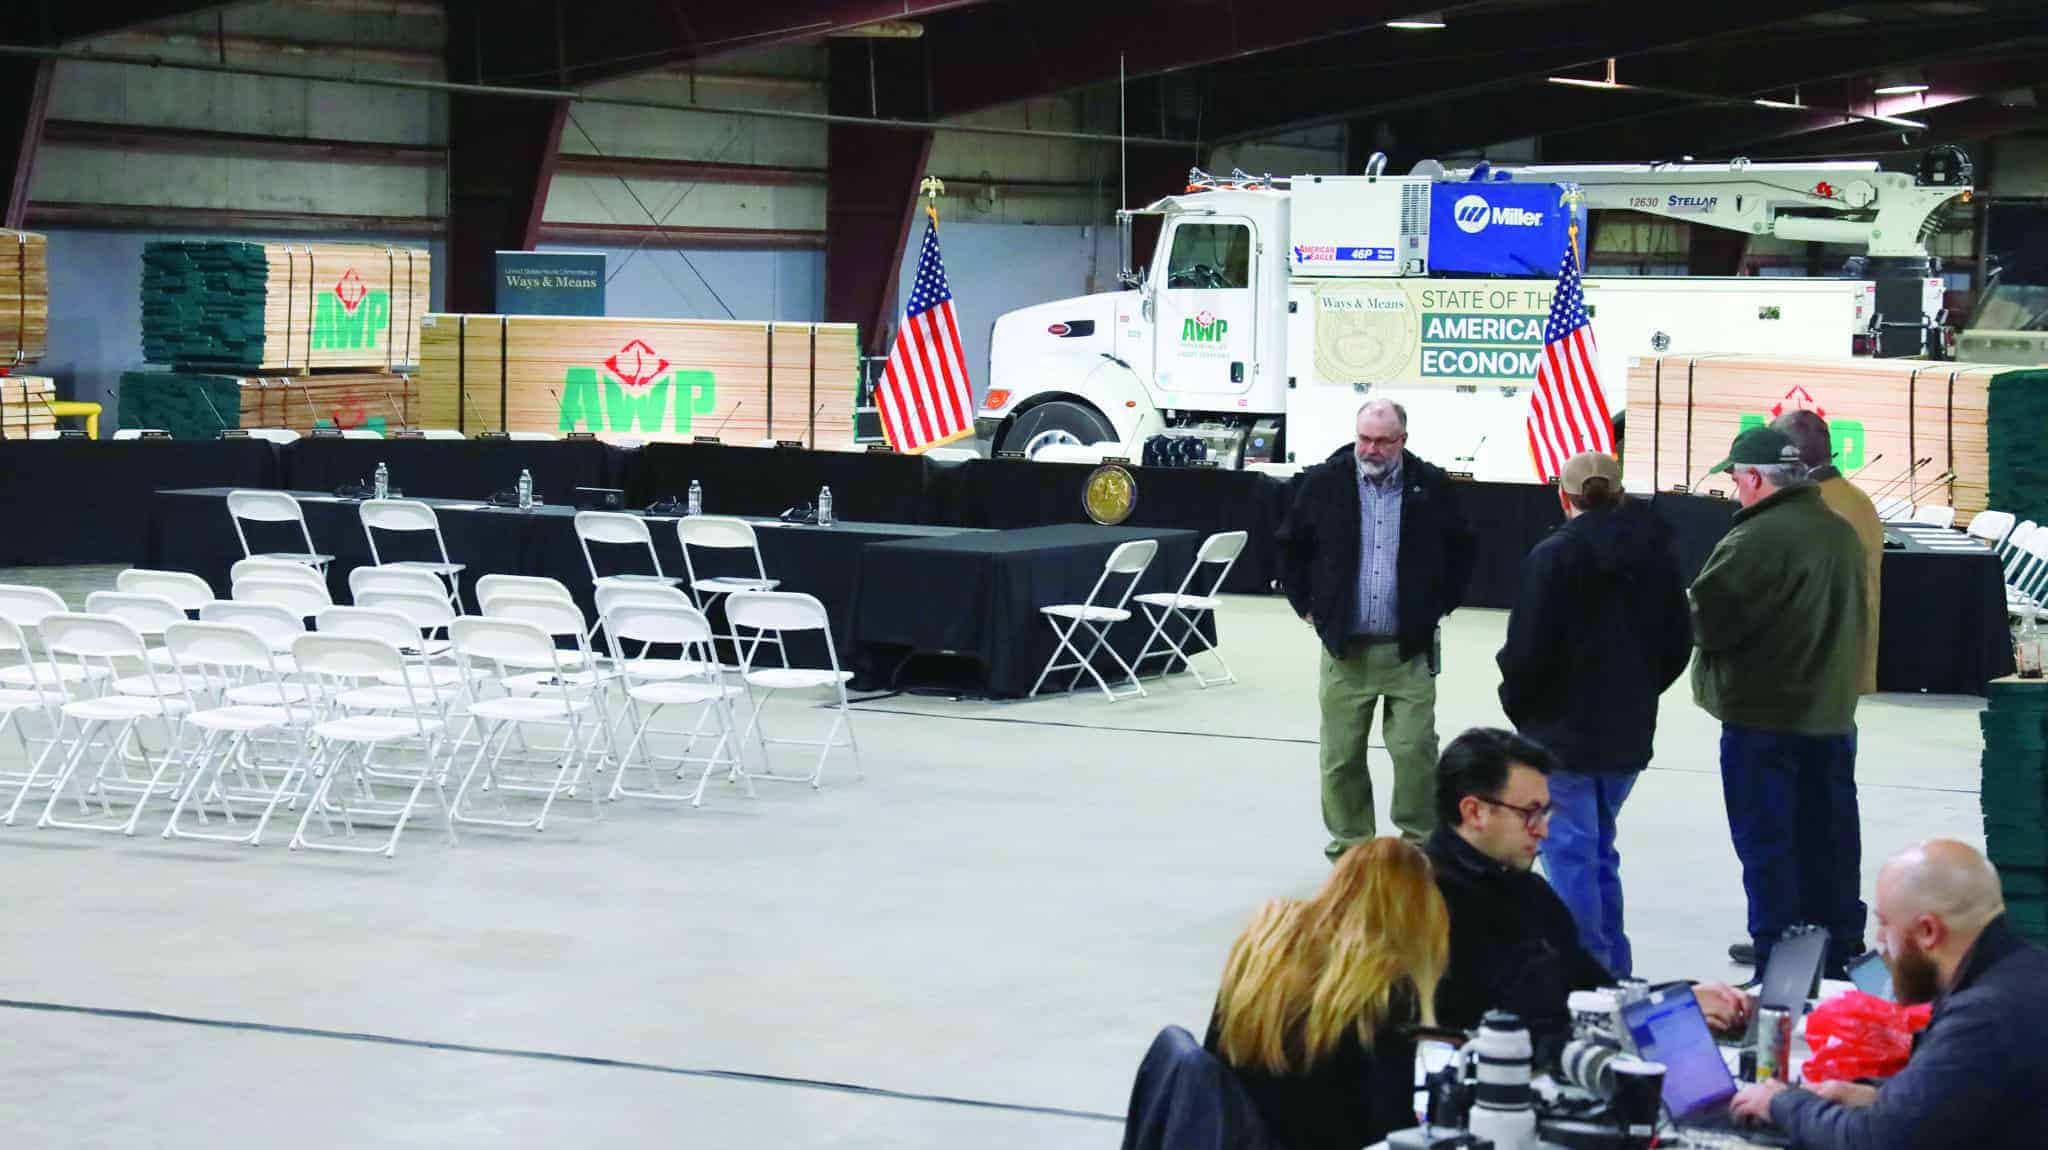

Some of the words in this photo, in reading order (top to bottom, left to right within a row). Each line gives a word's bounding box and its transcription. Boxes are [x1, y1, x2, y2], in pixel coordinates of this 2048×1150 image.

[1629, 196, 1659, 208] 12630
[1667, 194, 1719, 210] STELLAR
[1491, 206, 1544, 227] Miller
[1351, 248, 1374, 260] 46P
[505, 275, 540, 290] Ways
[541, 276, 553, 288] &
[555, 276, 598, 289] Means
[1321, 296, 1352, 311] Ways
[1354, 297, 1363, 309] &
[1367, 297, 1405, 309] Means
[1421, 289, 1484, 309] STATE
[1489, 290, 1518, 309] OF
[1523, 290, 1553, 310] TH
[313, 291, 388, 349] AWP
[1181, 317, 1229, 342] AWP
[1422, 349, 1541, 375] ECONOM
[557, 367, 718, 434] AWP
